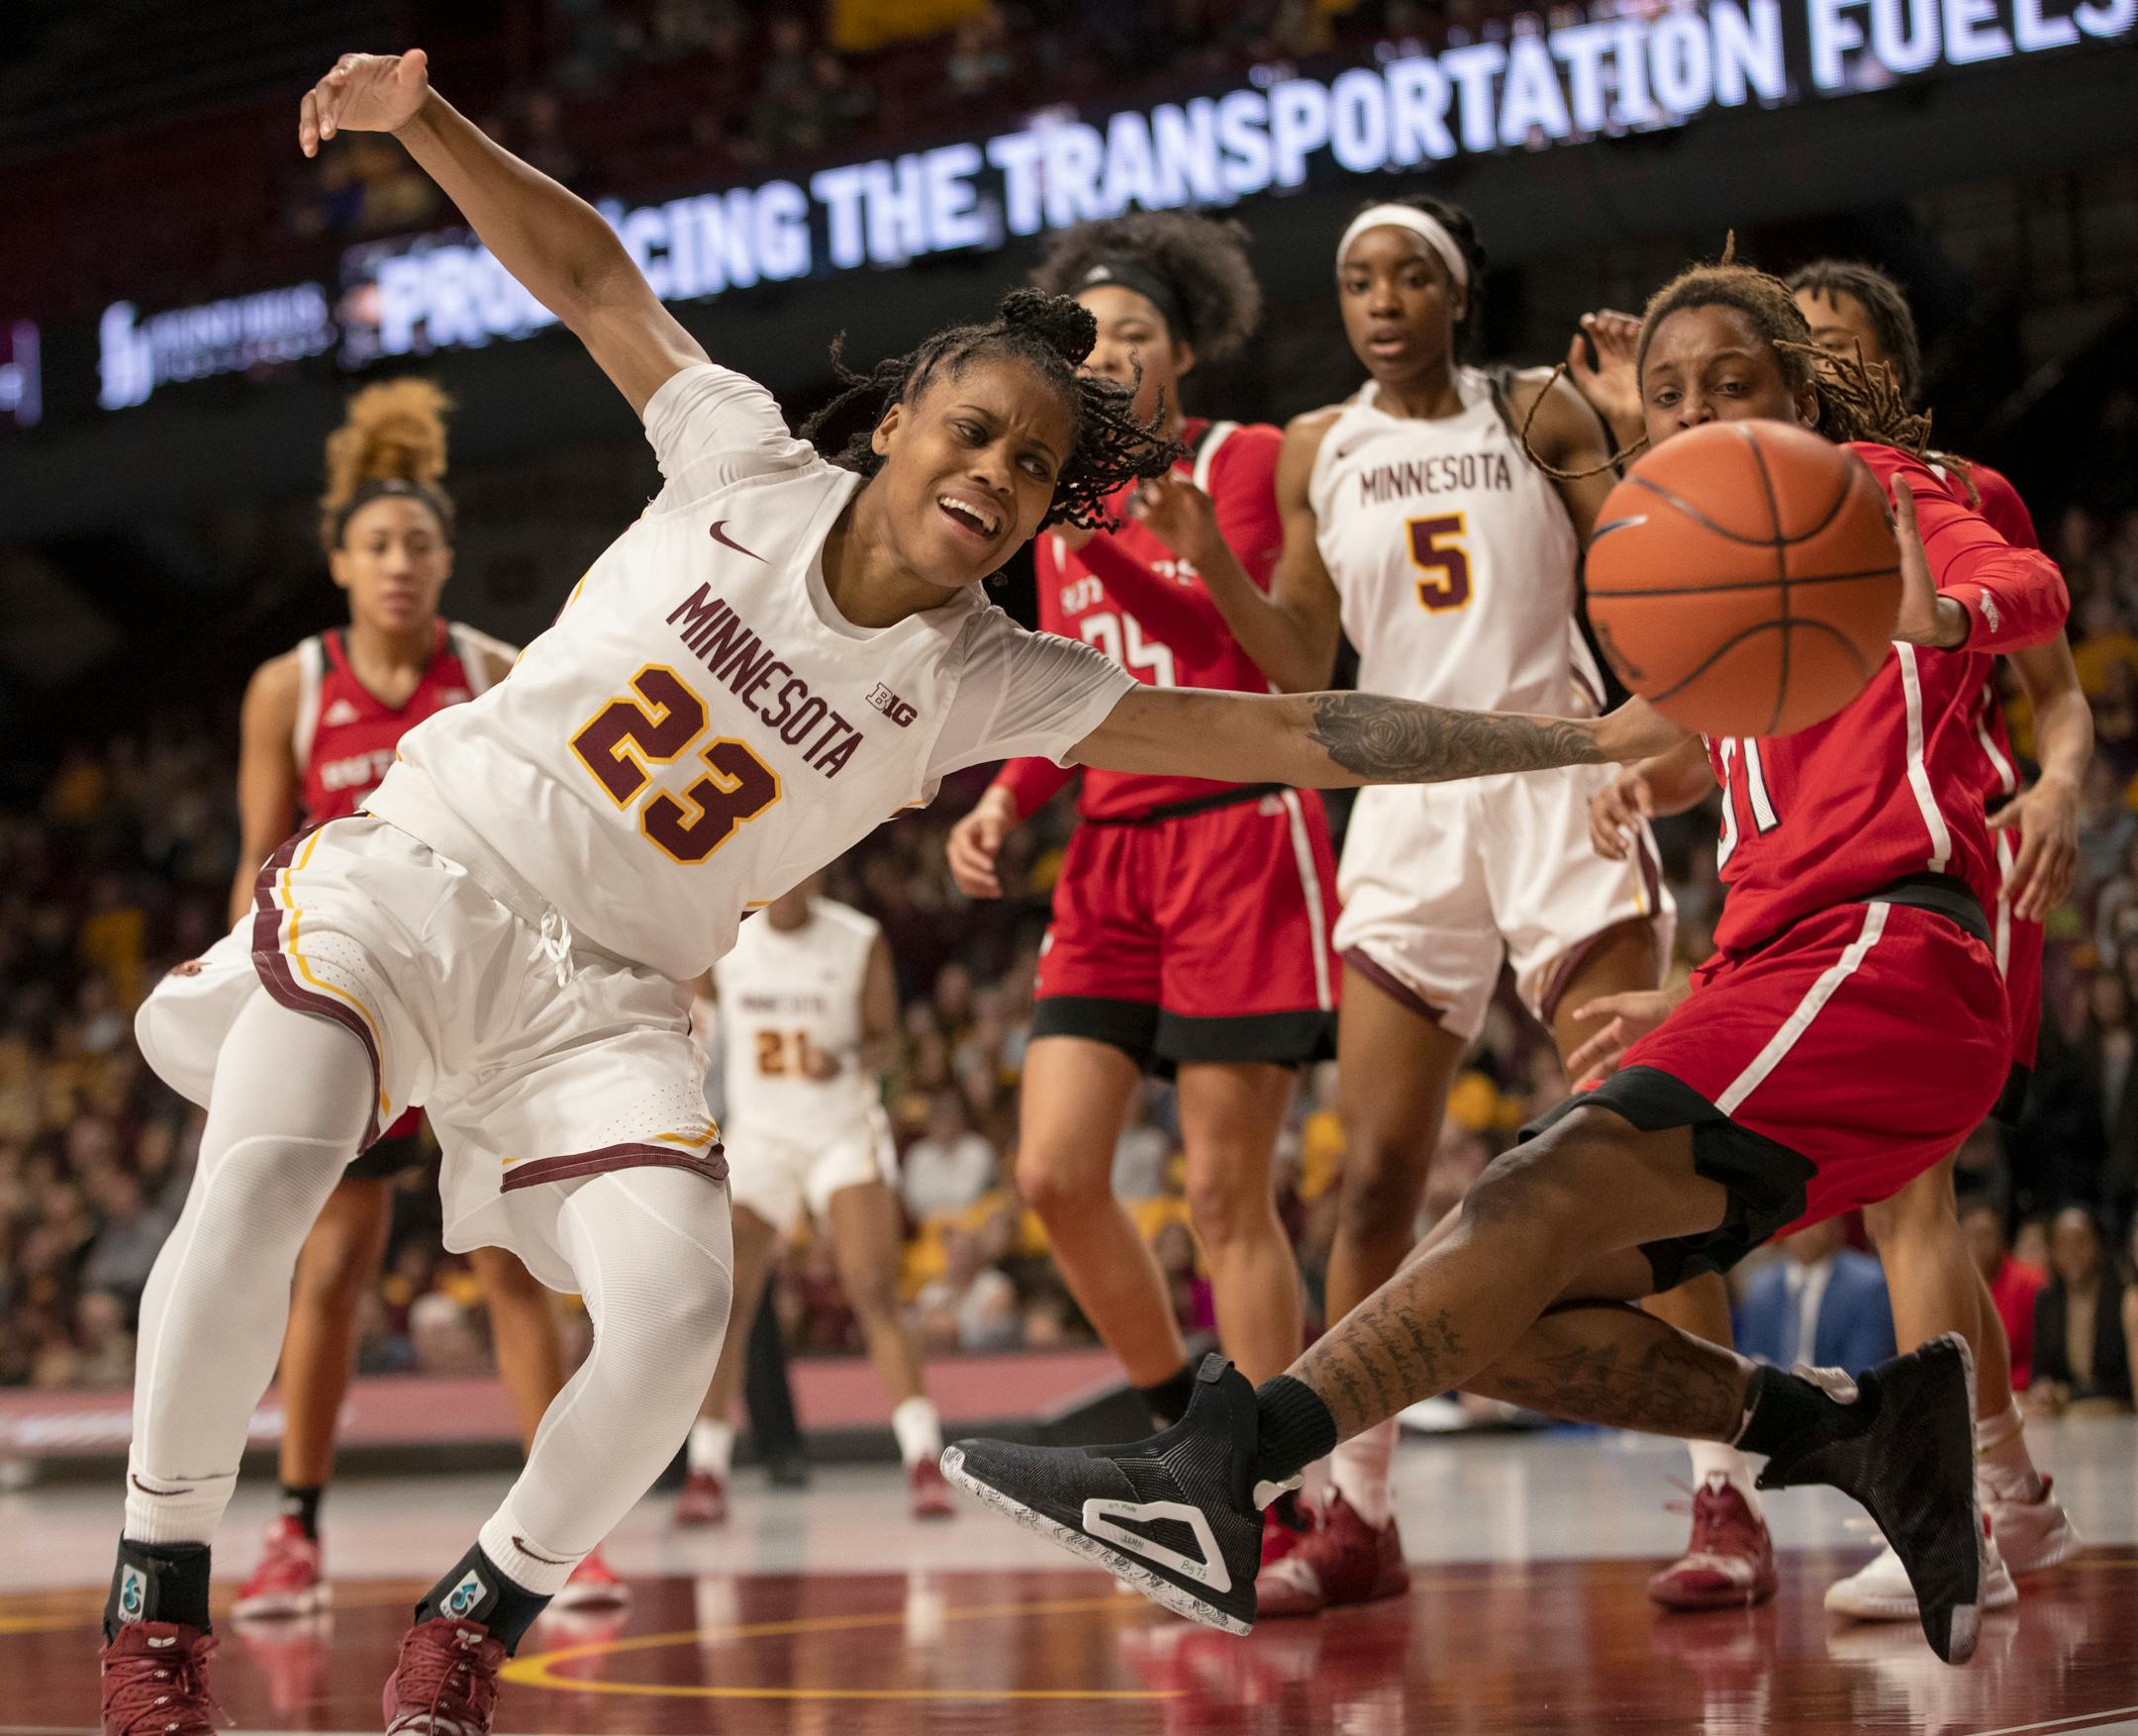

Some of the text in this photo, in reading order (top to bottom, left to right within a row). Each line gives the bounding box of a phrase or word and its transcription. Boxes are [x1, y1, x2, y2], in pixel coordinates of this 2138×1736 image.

[376, 176, 813, 356] PROCING
[810, 143, 990, 269] THE
[990, 0, 1788, 238] TRANSPORTATION
[1360, 452, 1513, 508] MINNESOTA
[1406, 510, 1474, 616] 5
[665, 581, 865, 780] MINNESOTA
[865, 681, 919, 728] BIG
[568, 663, 782, 866] 23
